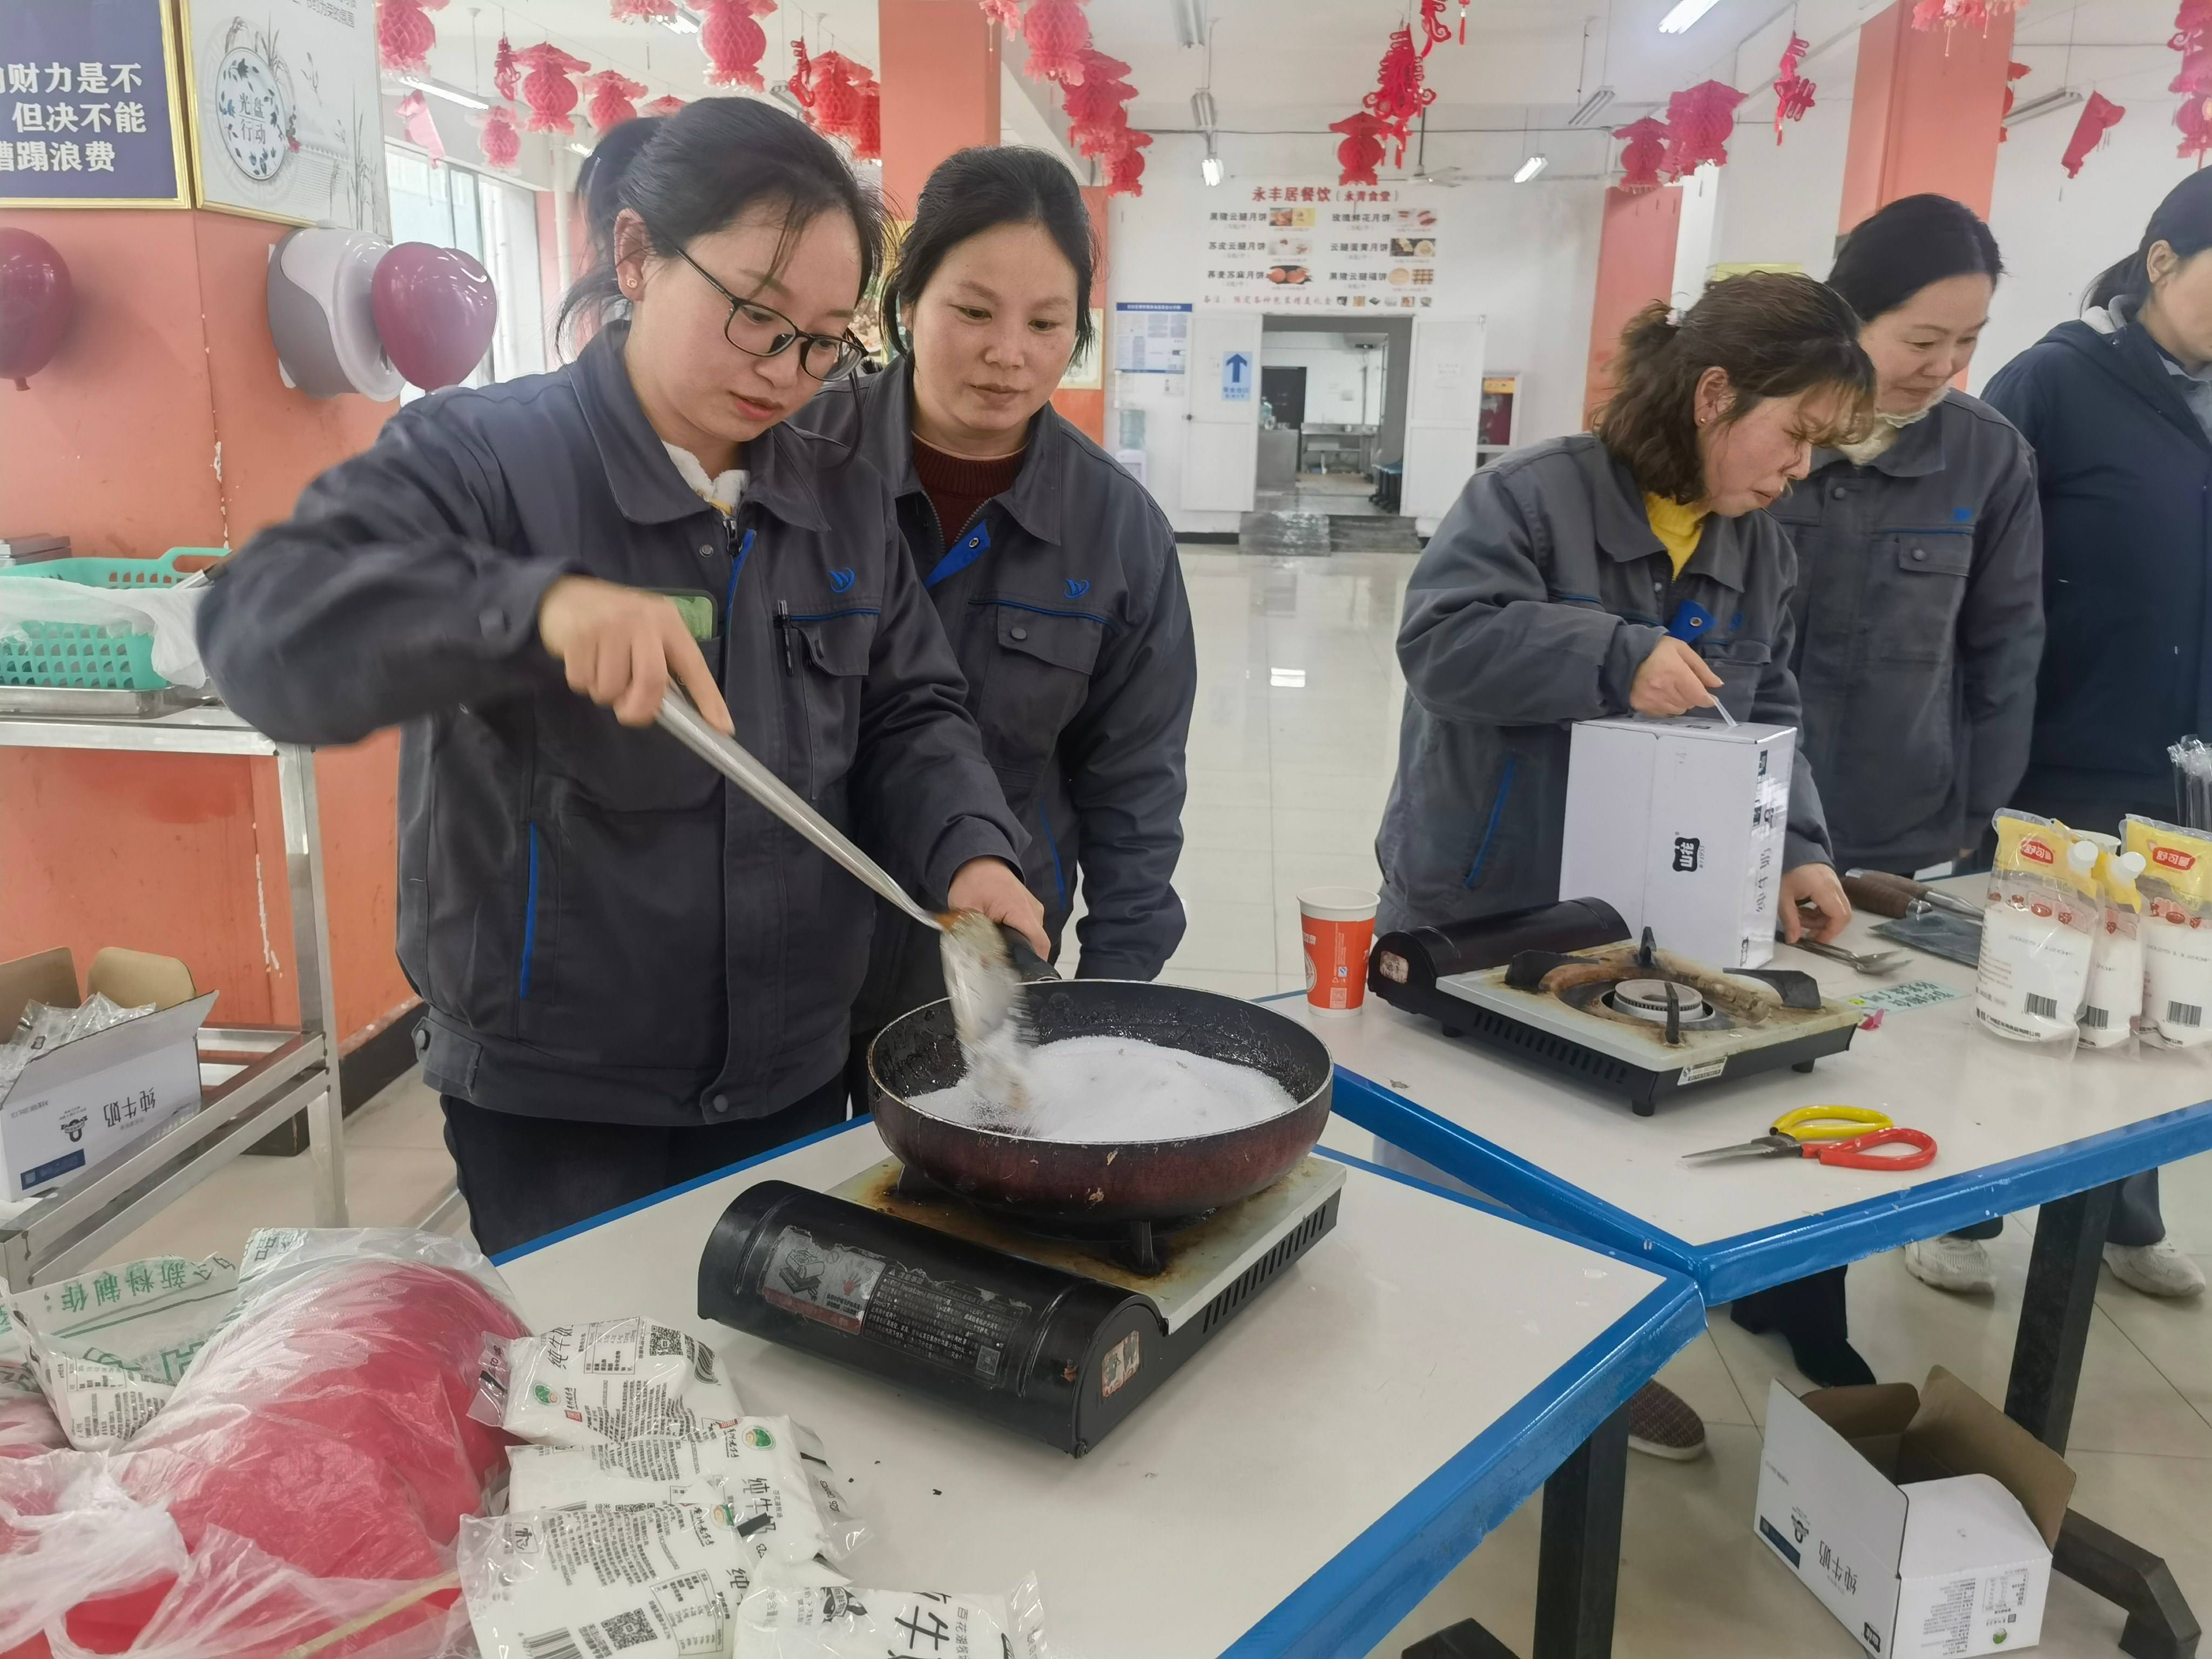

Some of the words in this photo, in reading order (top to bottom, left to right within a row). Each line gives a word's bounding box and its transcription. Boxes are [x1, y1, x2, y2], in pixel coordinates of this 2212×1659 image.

[0, 62, 143, 93] 财力是不
[12, 102, 147, 133] 但决不能
[240, 92, 265, 119] 光盘
[242, 119, 265, 145] 行动
[1680, 841, 1694, 868] 山花
[103, 1087, 156, 1128] 纯牛奶
